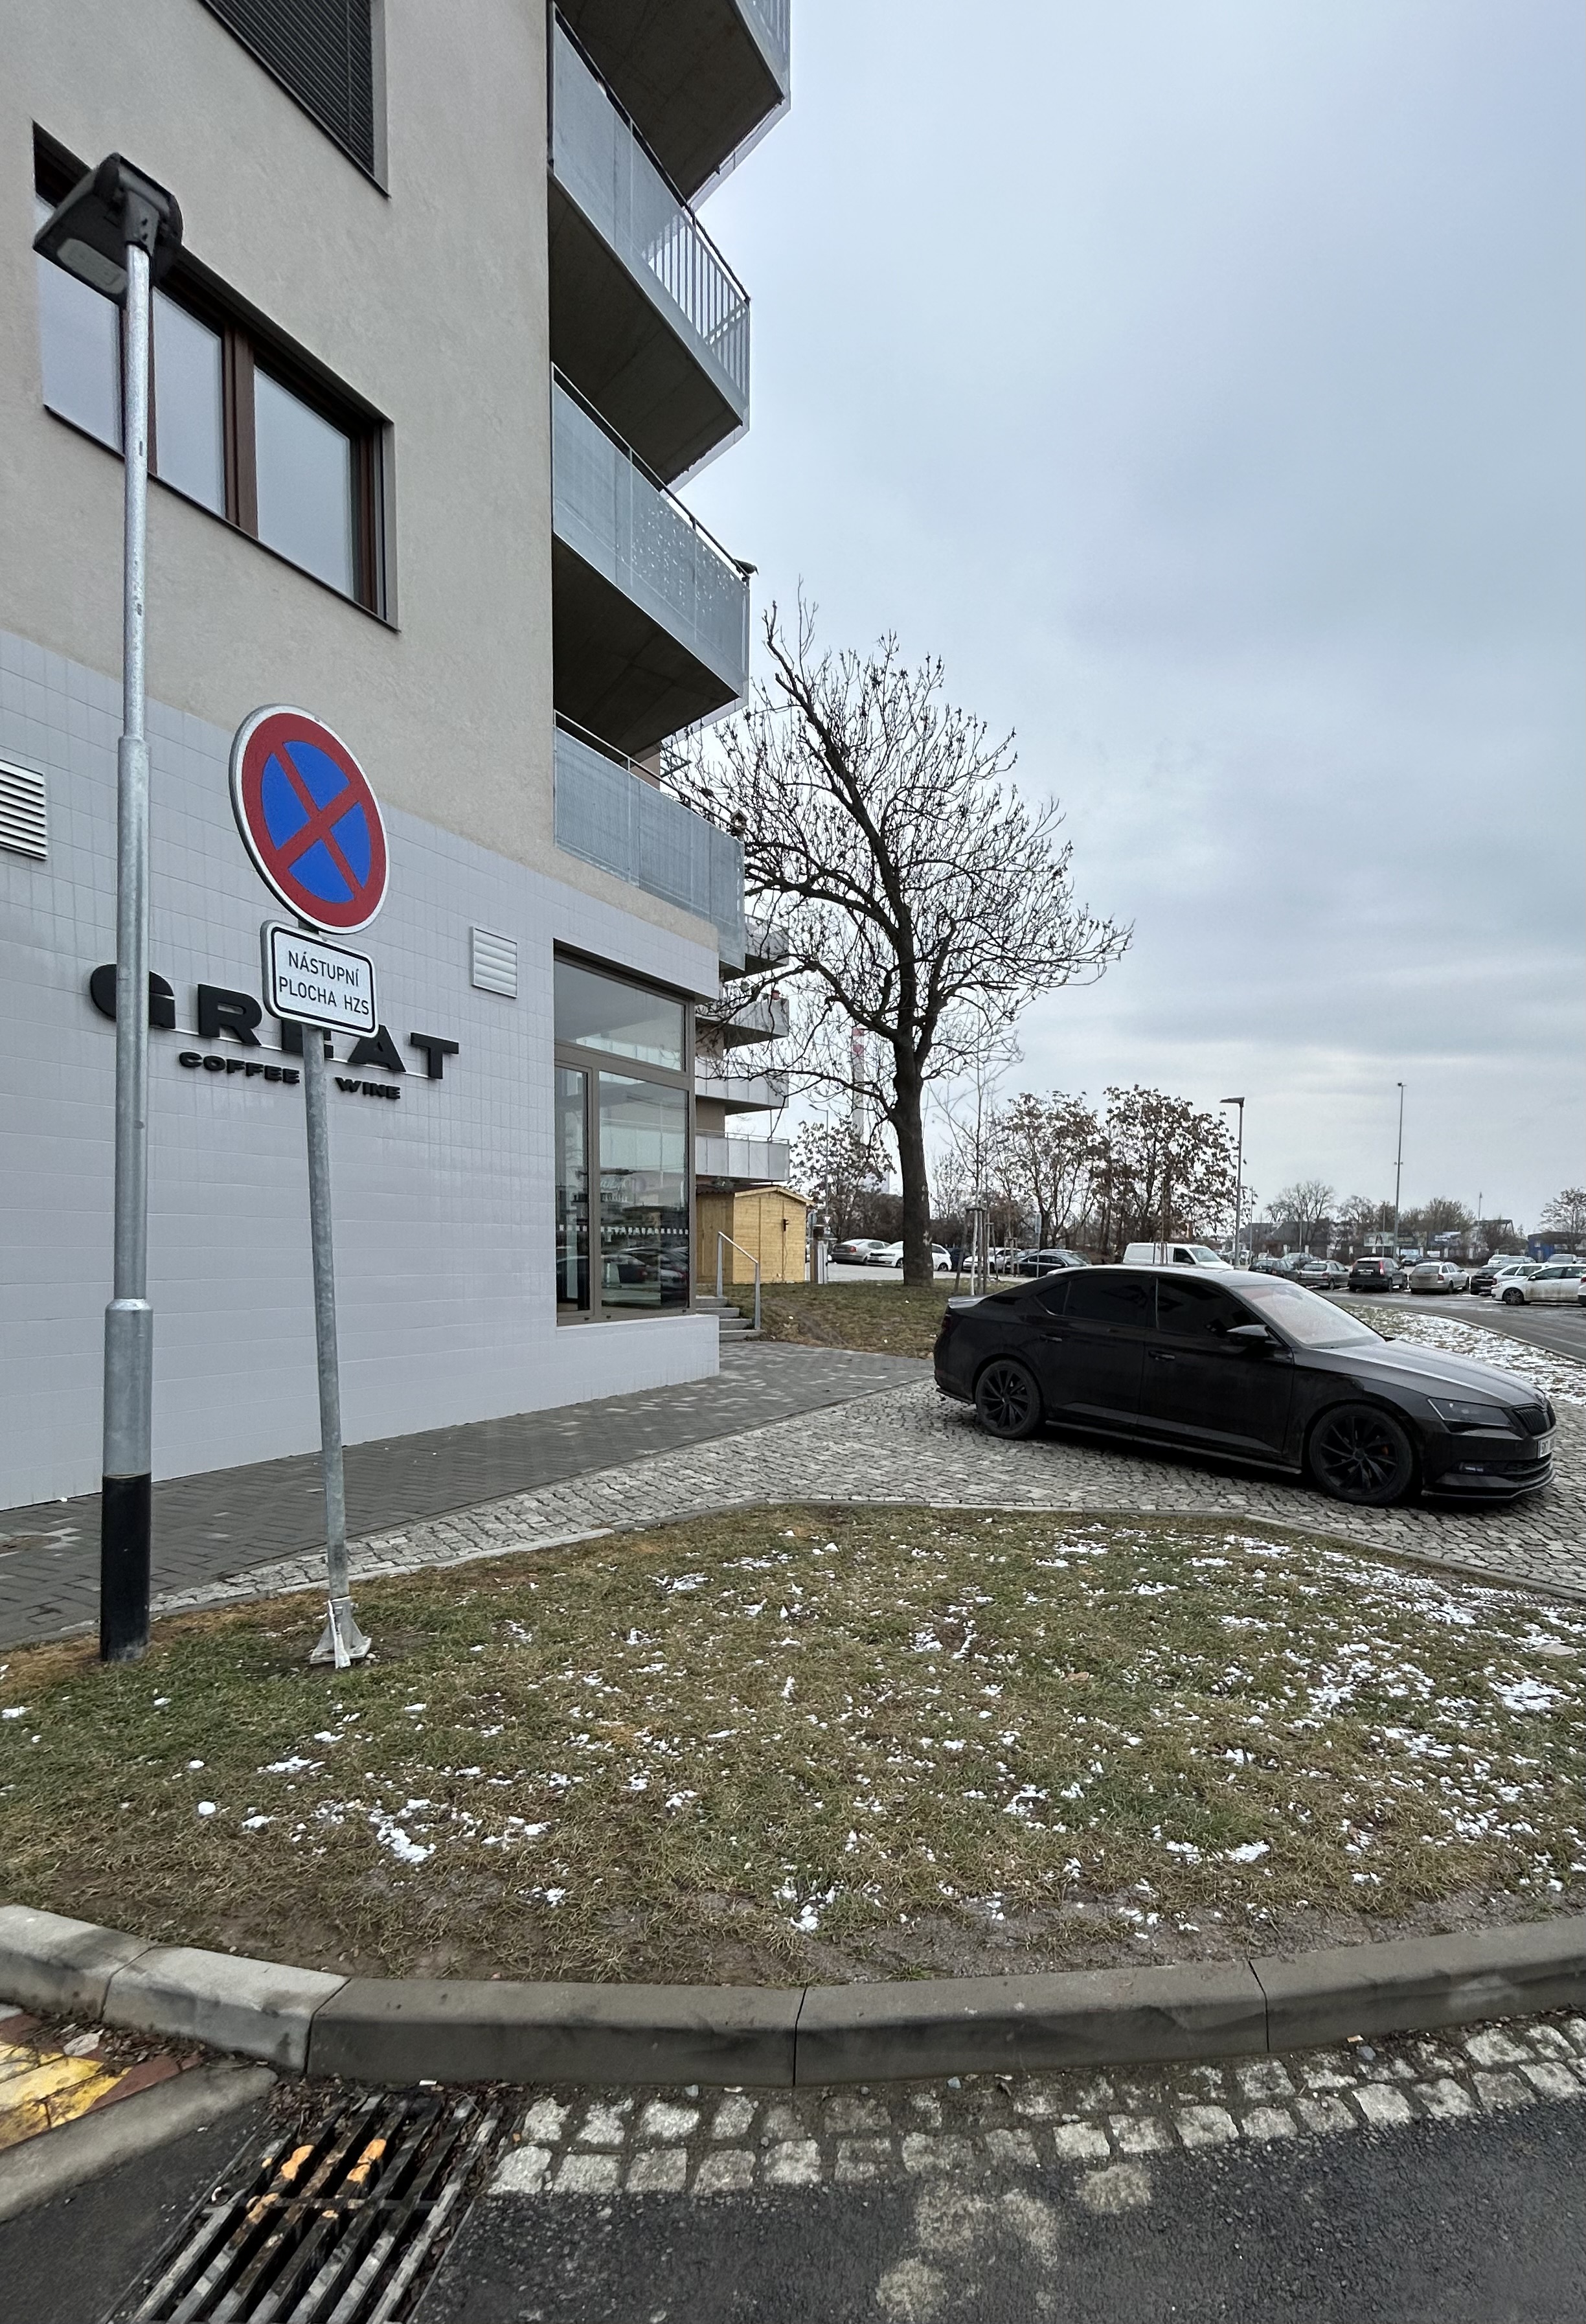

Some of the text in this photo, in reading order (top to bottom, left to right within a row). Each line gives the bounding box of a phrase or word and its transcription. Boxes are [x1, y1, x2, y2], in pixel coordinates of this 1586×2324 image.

[288, 950, 359, 987] NÁSTUPNÍ
[279, 975, 369, 1015] PLOCHA HZS
[91, 964, 459, 1079] GRAT
[179, 1051, 401, 1099] COFFEE WINE
